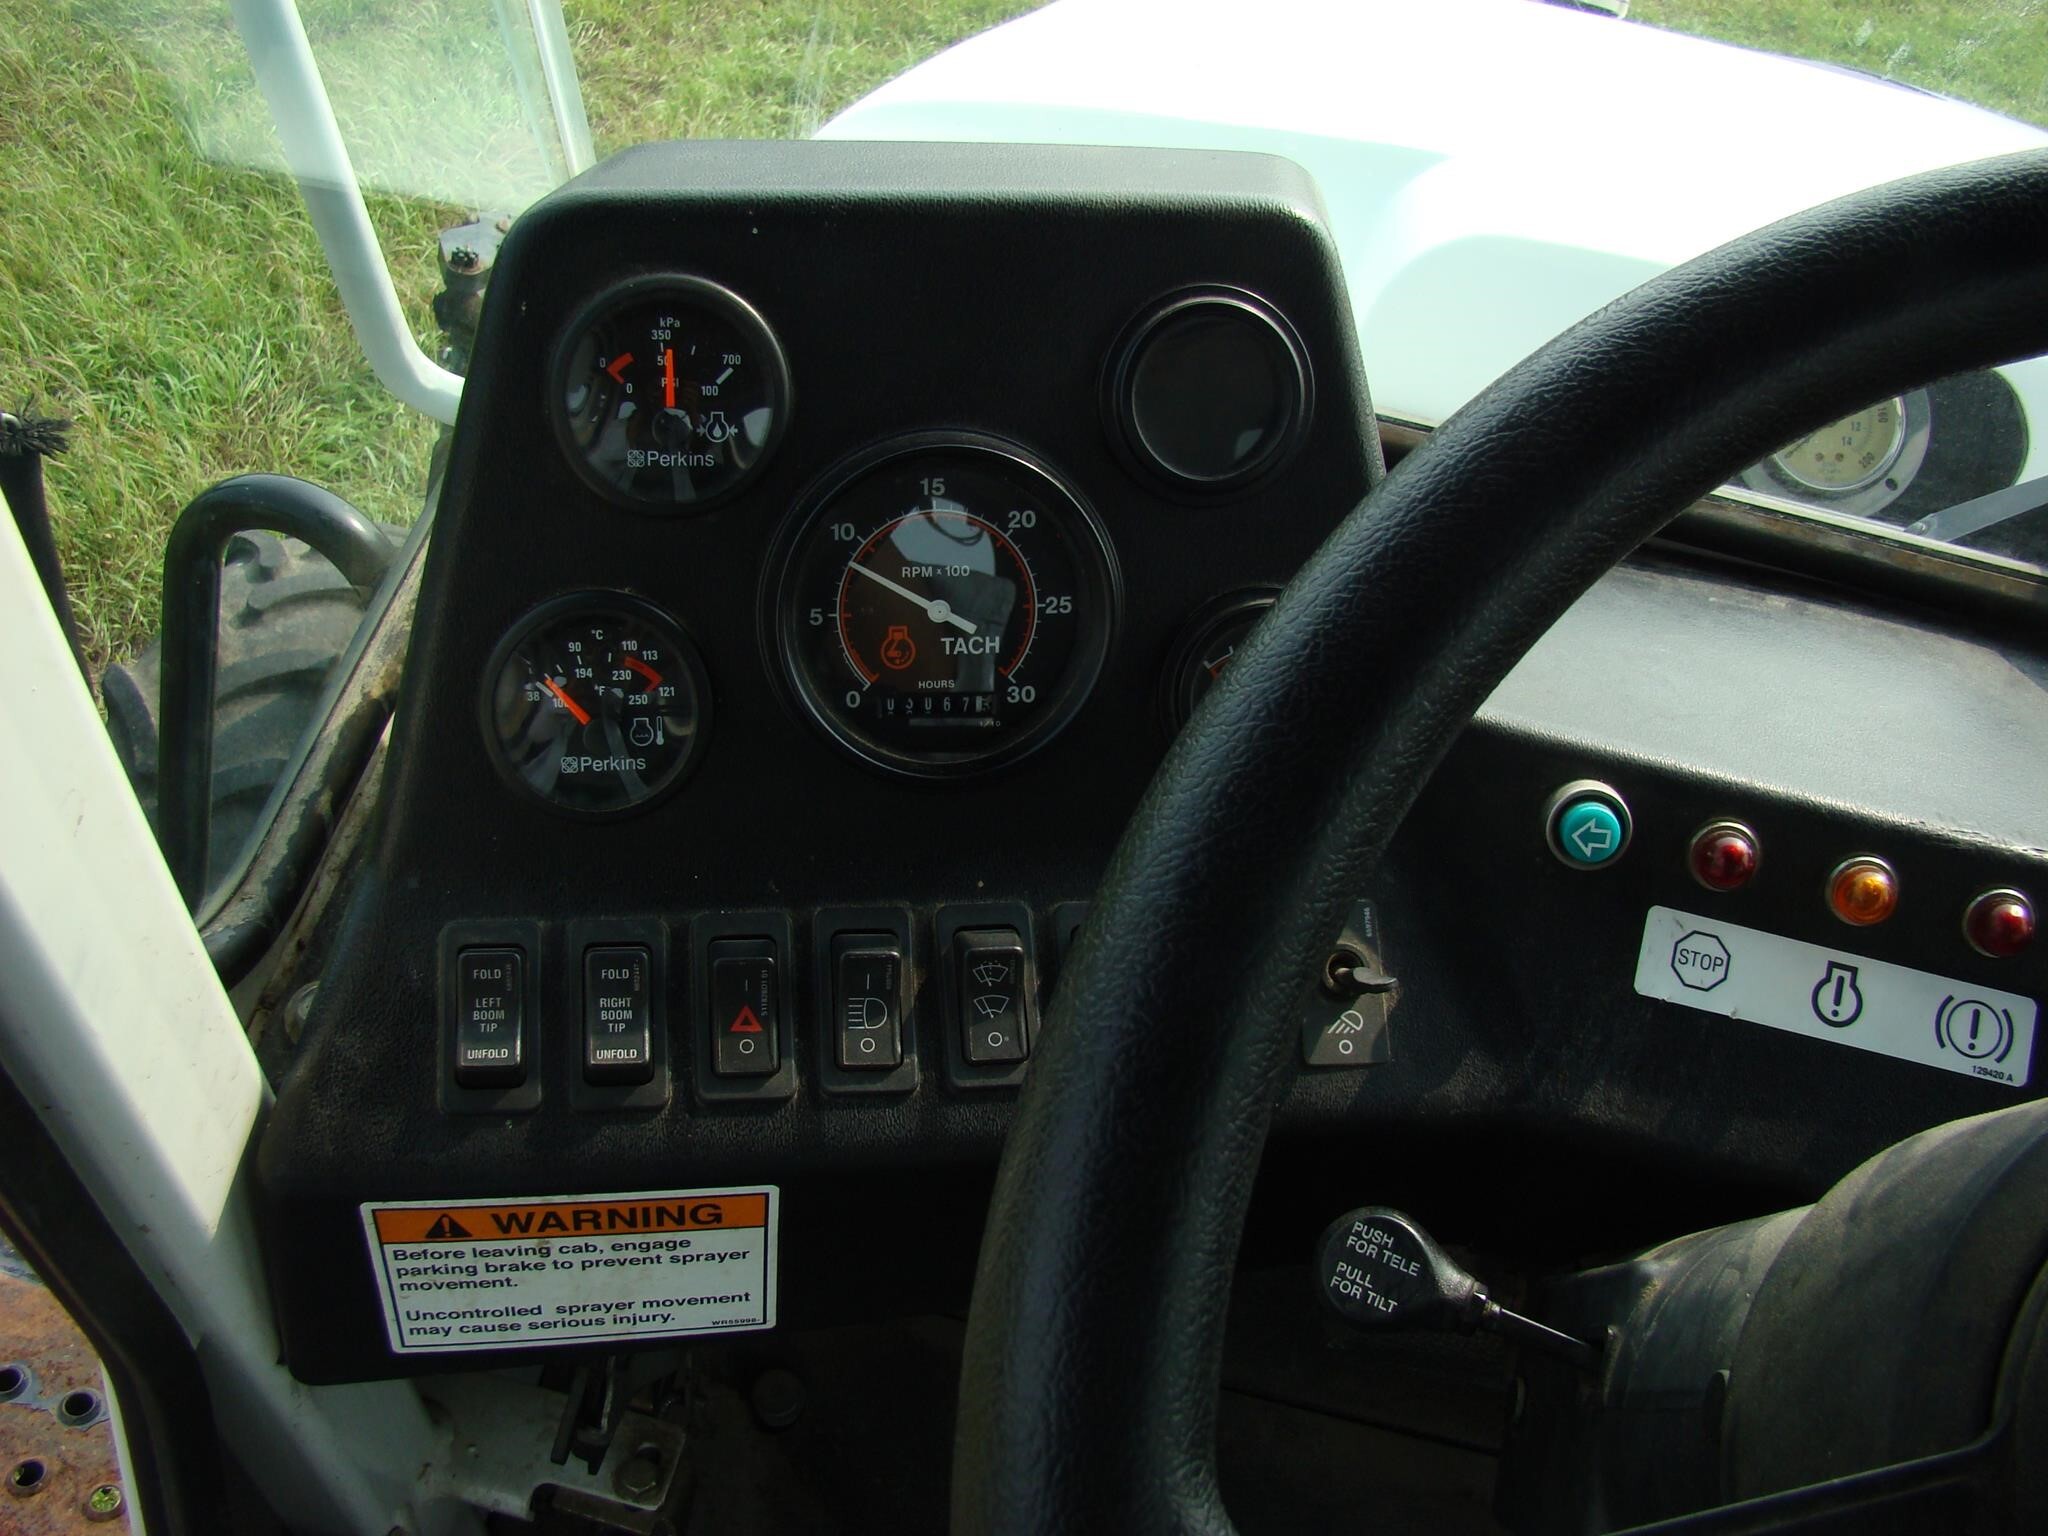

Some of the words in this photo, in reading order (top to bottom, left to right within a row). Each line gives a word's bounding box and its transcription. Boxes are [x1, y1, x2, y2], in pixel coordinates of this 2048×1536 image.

[660, 317, 680, 328] kPa
[651, 329, 671, 340] 350
[599, 358, 606, 368] 0
[722, 354, 741, 365] 700
[626, 383, 633, 394] 0
[701, 385, 719, 396] 100
[647, 451, 715, 467] Perkins
[920, 477, 946, 496] 15
[1008, 510, 1036, 529] 20
[830, 522, 855, 541] 10
[901, 566, 933, 578] RPM
[945, 565, 970, 577] 100
[1045, 596, 1073, 615] 25
[809, 608, 824, 625] 5
[568, 642, 582, 652] 90
[622, 640, 638, 651] 110
[940, 635, 1001, 655] TACH
[642, 650, 658, 661] 113
[575, 668, 593, 678] 194
[612, 670, 632, 681] 230
[918, 679, 955, 689] HOURS
[527, 691, 541, 701] 38
[659, 687, 675, 698] 121
[1007, 685, 1036, 704] 30
[628, 694, 648, 705] 250
[846, 691, 861, 708] 0
[580, 756, 646, 772] Perkins
[1678, 948, 1724, 973] STOP
[473, 969, 502, 979] FOLD
[601, 968, 630, 979] FOLD
[475, 998, 502, 1008] LEFT
[600, 997, 632, 1008] RIGHT
[473, 1010, 505, 1020] BOOM
[601, 1010, 633, 1020] BOOM
[480, 1022, 498, 1032] TIP
[608, 1022, 626, 1032] TIP
[467, 1048, 508, 1059] UNFOLD
[596, 1048, 638, 1059] UNFOLD
[491, 1203, 723, 1235] WARNING
[1351, 1221, 1394, 1249] PUSH
[393, 1248, 466, 1261] Before
[472, 1245, 551, 1258] leaving
[558, 1242, 603, 1255] cab,
[611, 1239, 692, 1253] engage
[1346, 1235, 1378, 1260] FOR
[1383, 1249, 1421, 1277] TELE
[396, 1263, 478, 1279] parking
[485, 1261, 546, 1273] brake
[552, 1259, 574, 1270] to
[581, 1254, 663, 1271] prevent
[669, 1249, 751, 1265] sprayer
[1336, 1261, 1373, 1289] PULL
[400, 1276, 518, 1291] movement.
[1329, 1275, 1362, 1300] FOR
[1367, 1290, 1398, 1313] TILT
[406, 1305, 543, 1321] Uncontrolled
[556, 1301, 636, 1315] sprayer
[642, 1292, 751, 1309] movement
[409, 1325, 452, 1337] may
[459, 1321, 522, 1334] cause
[528, 1317, 606, 1330] serious
[613, 1312, 676, 1327] injury.
